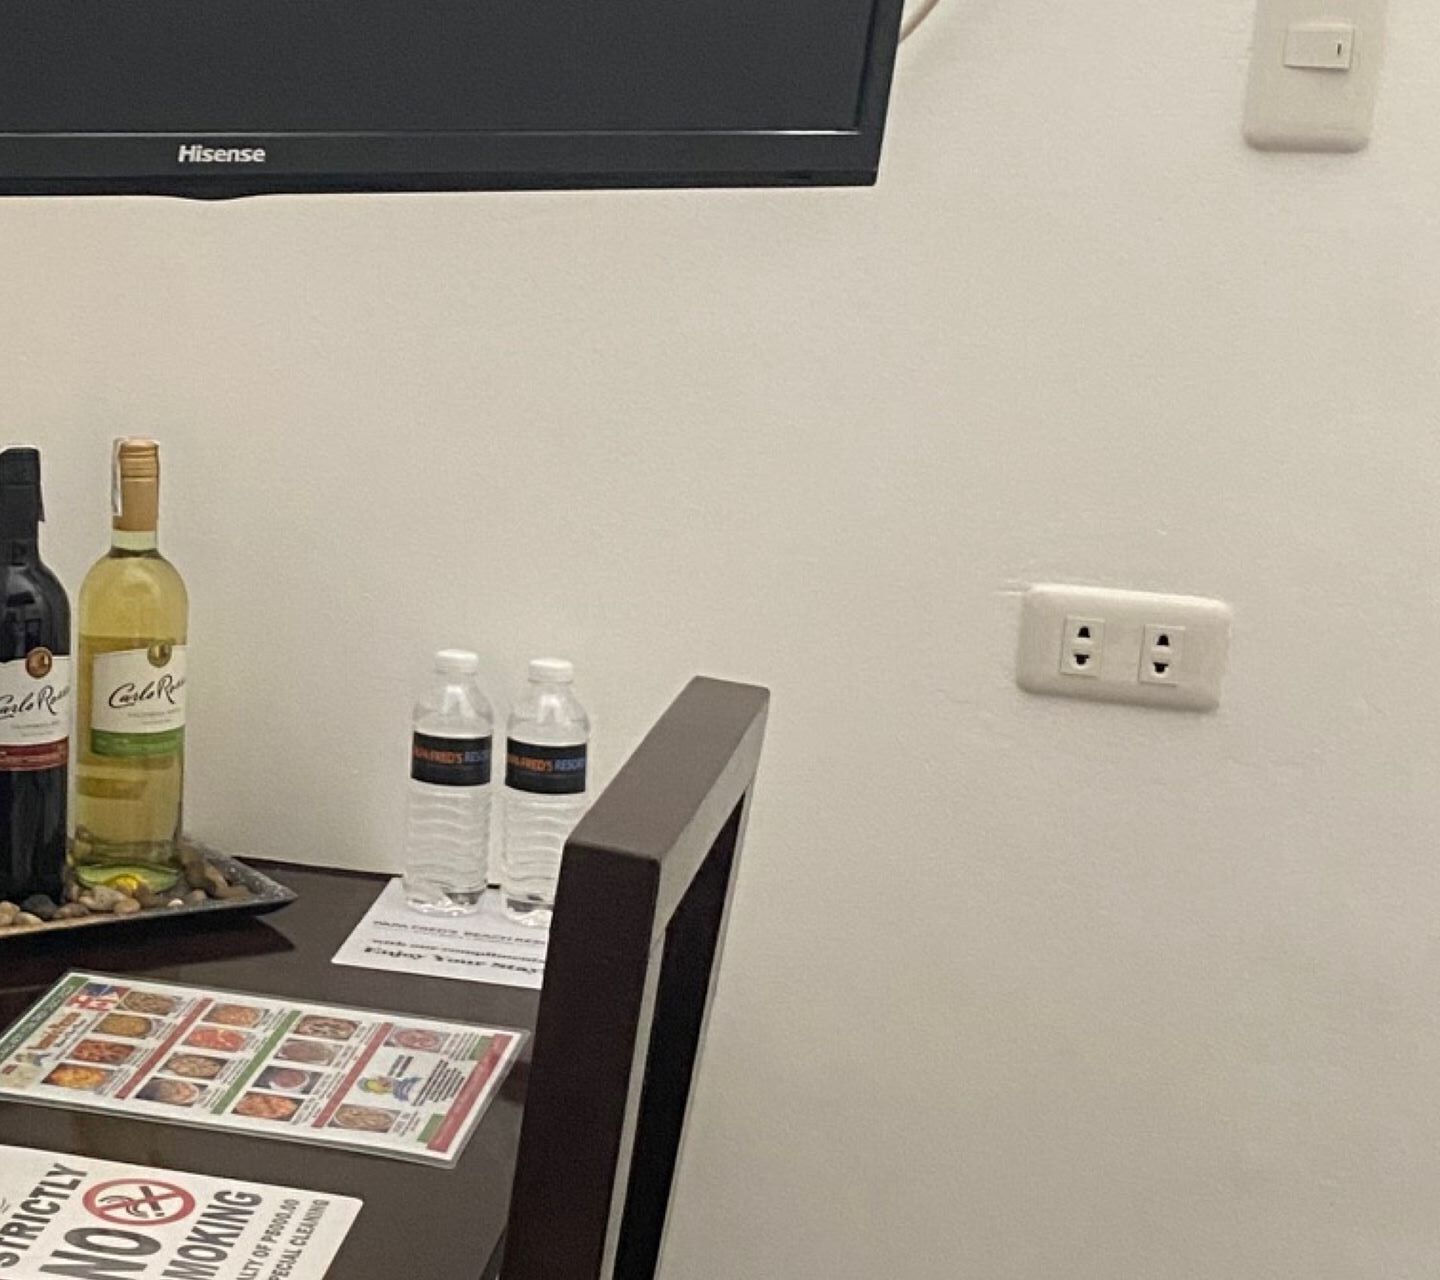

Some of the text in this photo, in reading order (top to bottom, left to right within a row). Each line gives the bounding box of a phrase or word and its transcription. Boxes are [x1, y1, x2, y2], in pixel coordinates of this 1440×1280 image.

[177, 144, 266, 163] Hisense
[108, 680, 155, 709] Carlo
[364, 945, 539, 976] Enjoy Your Stay
[290, 1199, 331, 1246] CLEANING
[251, 1243, 272, 1258] OF
